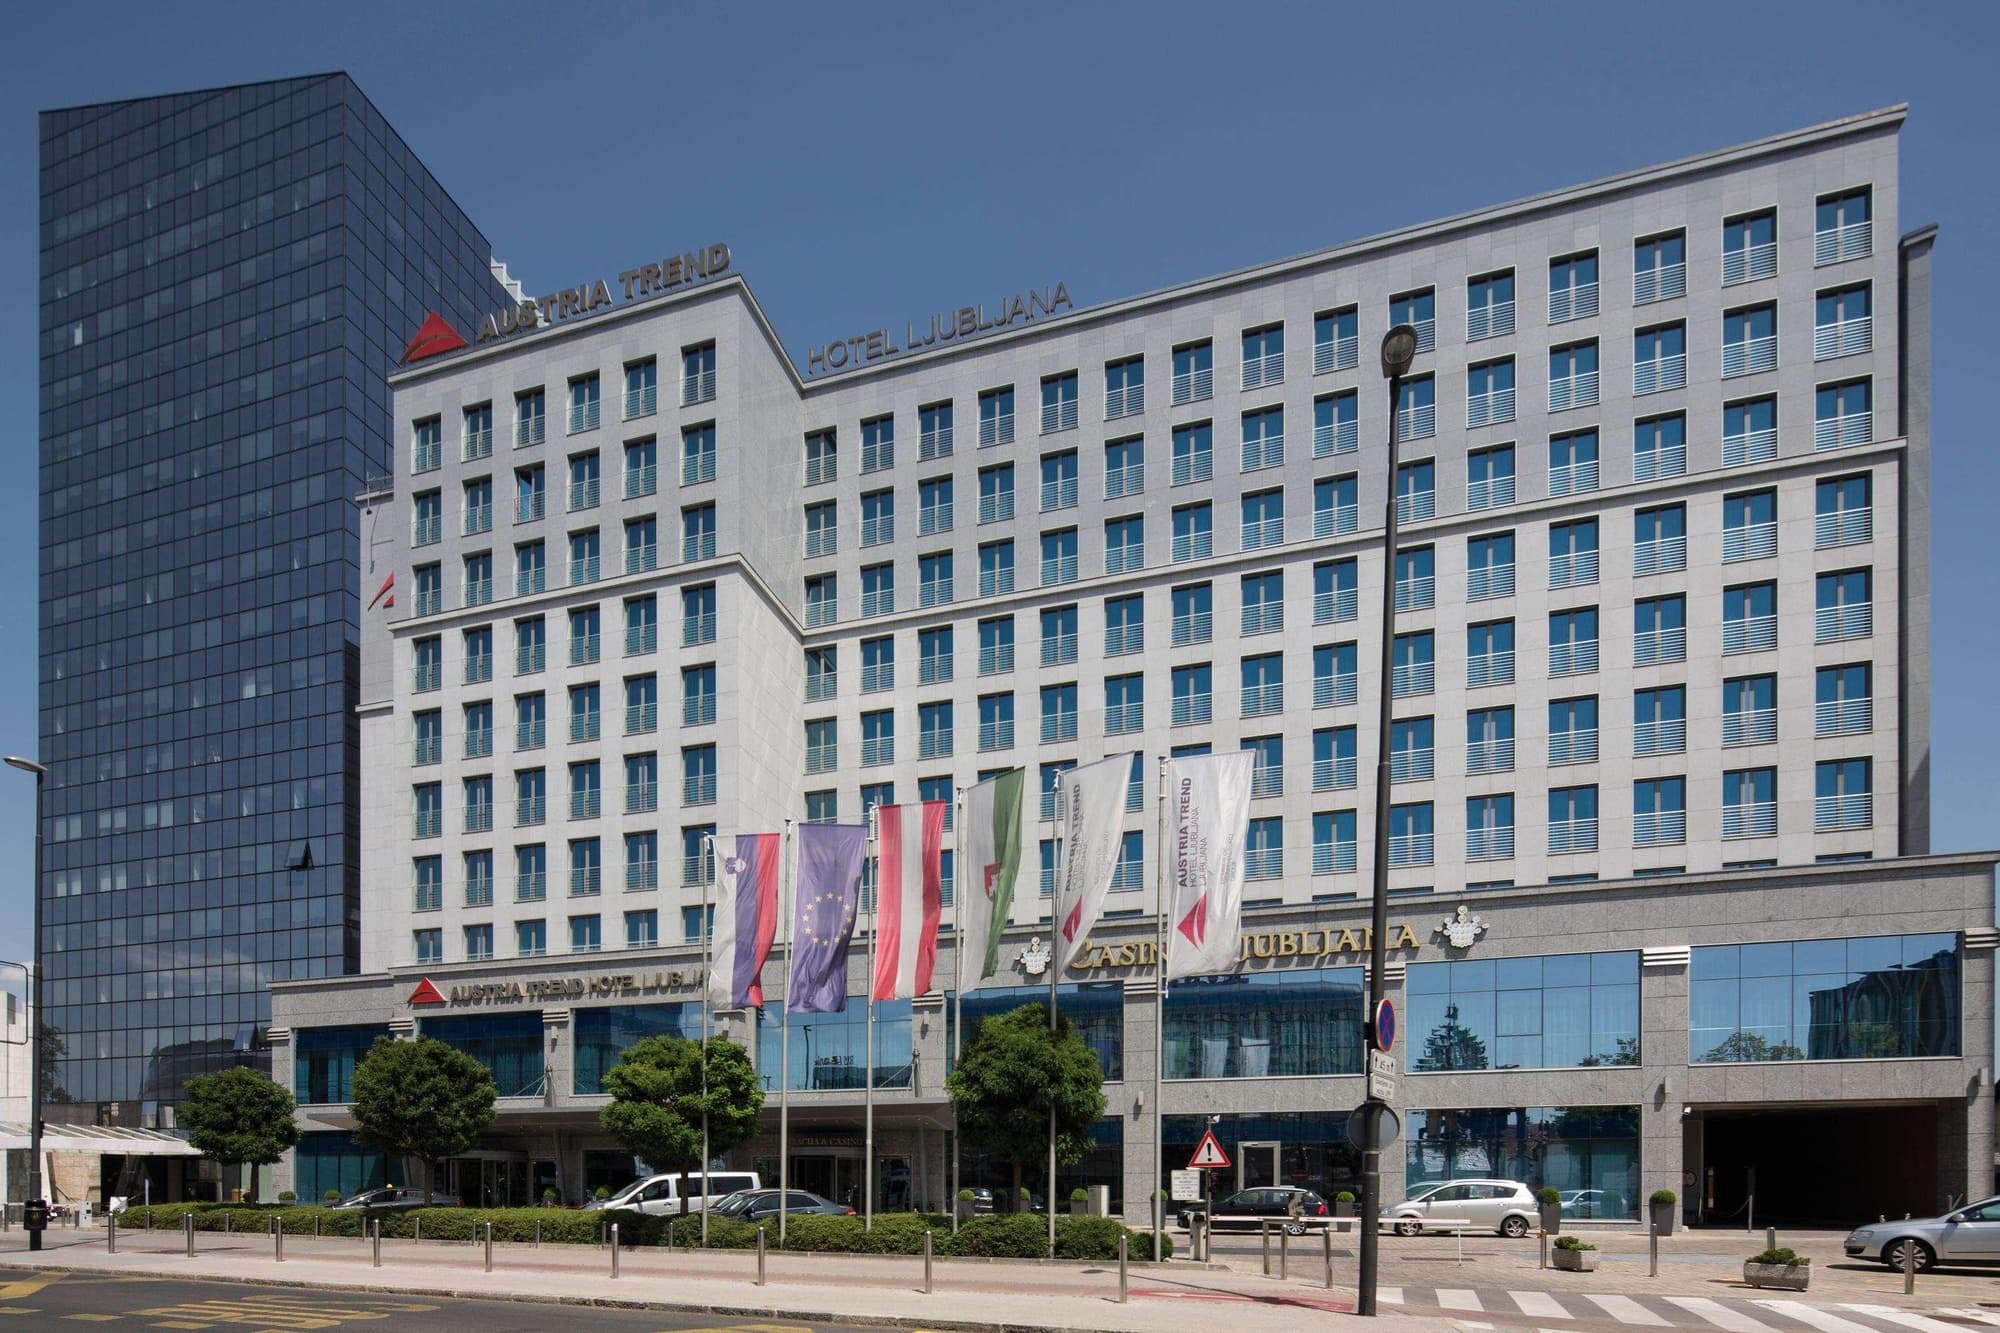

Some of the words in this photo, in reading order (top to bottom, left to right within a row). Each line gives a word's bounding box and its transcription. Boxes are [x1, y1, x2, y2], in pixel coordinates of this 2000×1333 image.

[477, 279, 612, 342] AUSTRIA
[618, 243, 731, 299] TREND
[808, 328, 899, 374] HOTEL
[907, 281, 1073, 349] LJUBLJANA
[1179, 777, 1192, 824] TREND
[1065, 833, 1078, 891] AUSTRIA
[1072, 783, 1081, 830] TREND
[1190, 806, 1200, 855] LJUBLJANA
[1177, 825, 1189, 888] AUSTRIA
[1189, 856, 1198, 888] HOTEL
[1071, 938, 1168, 969] CASIN
[451, 980, 524, 1001] AUSTRIA
[526, 976, 585, 996] TREND
[588, 973, 639, 993] HOTEL
